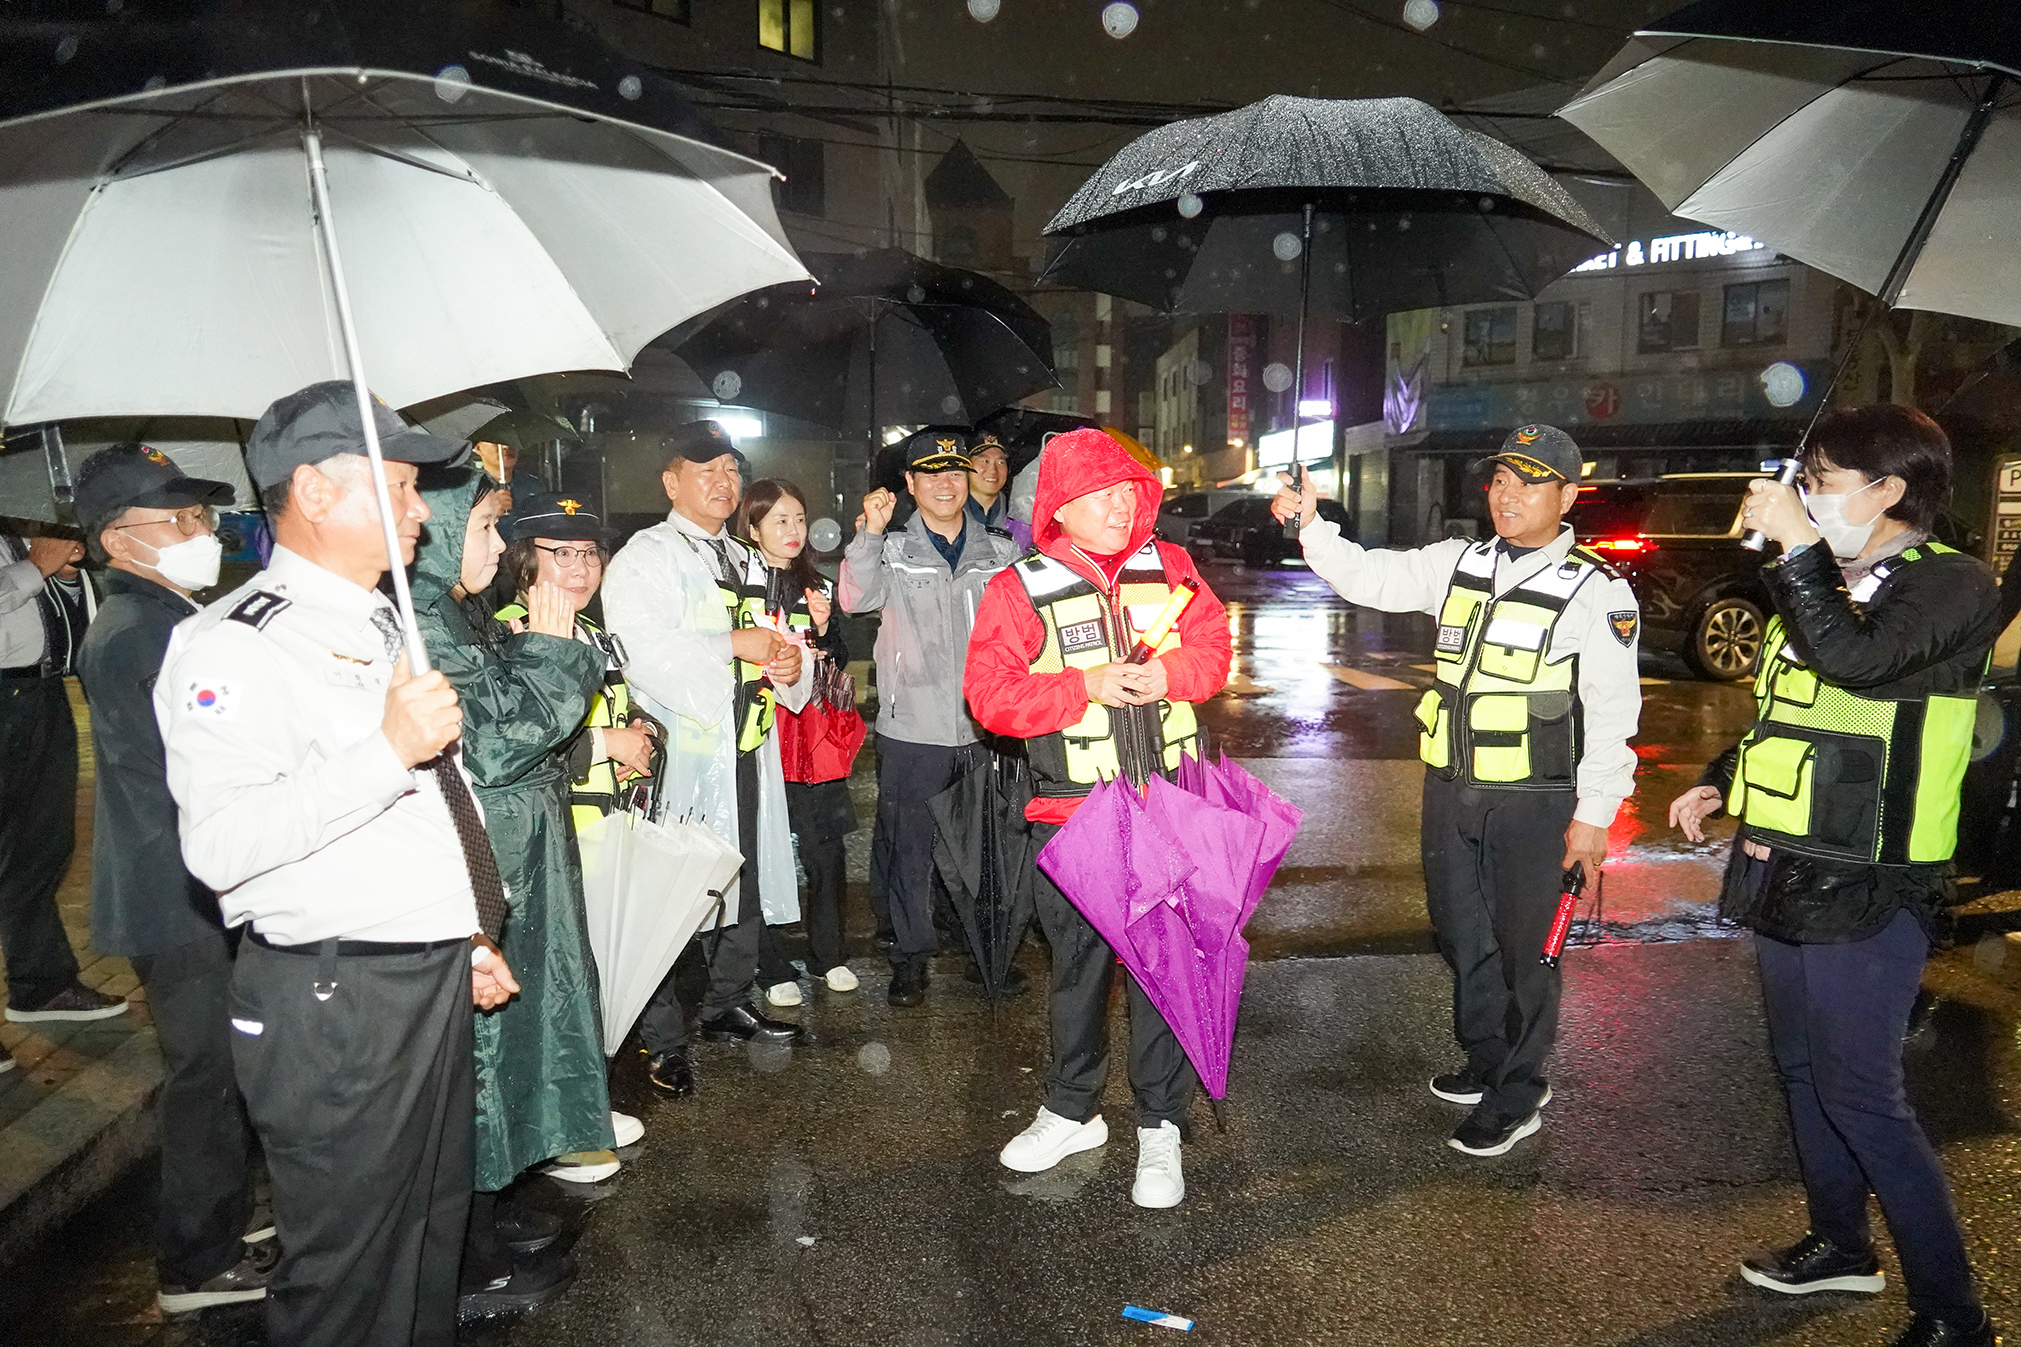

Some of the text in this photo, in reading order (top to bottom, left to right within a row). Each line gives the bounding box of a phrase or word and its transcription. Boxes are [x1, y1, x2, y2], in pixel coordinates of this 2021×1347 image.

[1626, 241, 1645, 266] &
[1065, 623, 1097, 643] 방범
[1442, 628, 1461, 644] 방범
